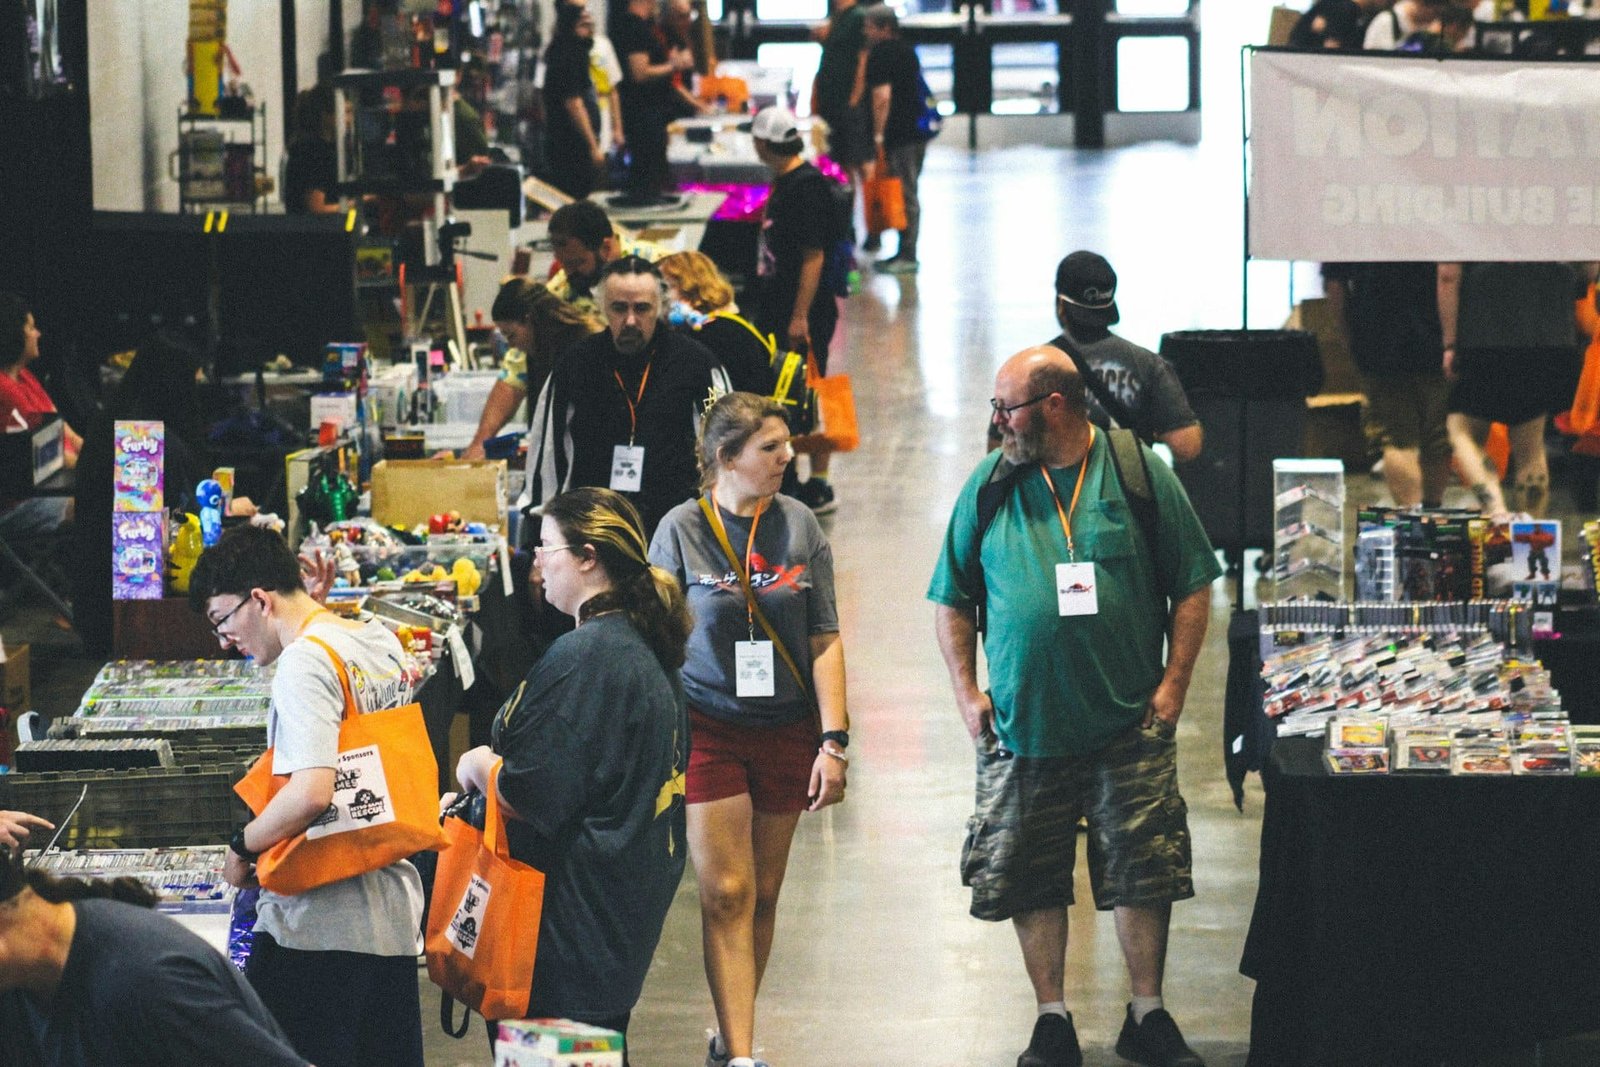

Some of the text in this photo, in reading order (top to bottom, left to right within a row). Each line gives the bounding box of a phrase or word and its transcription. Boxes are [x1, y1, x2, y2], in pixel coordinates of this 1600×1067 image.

[121, 435, 158, 454] Furby
[117, 521, 155, 541] Furby
[342, 750, 374, 763] Sponsors
